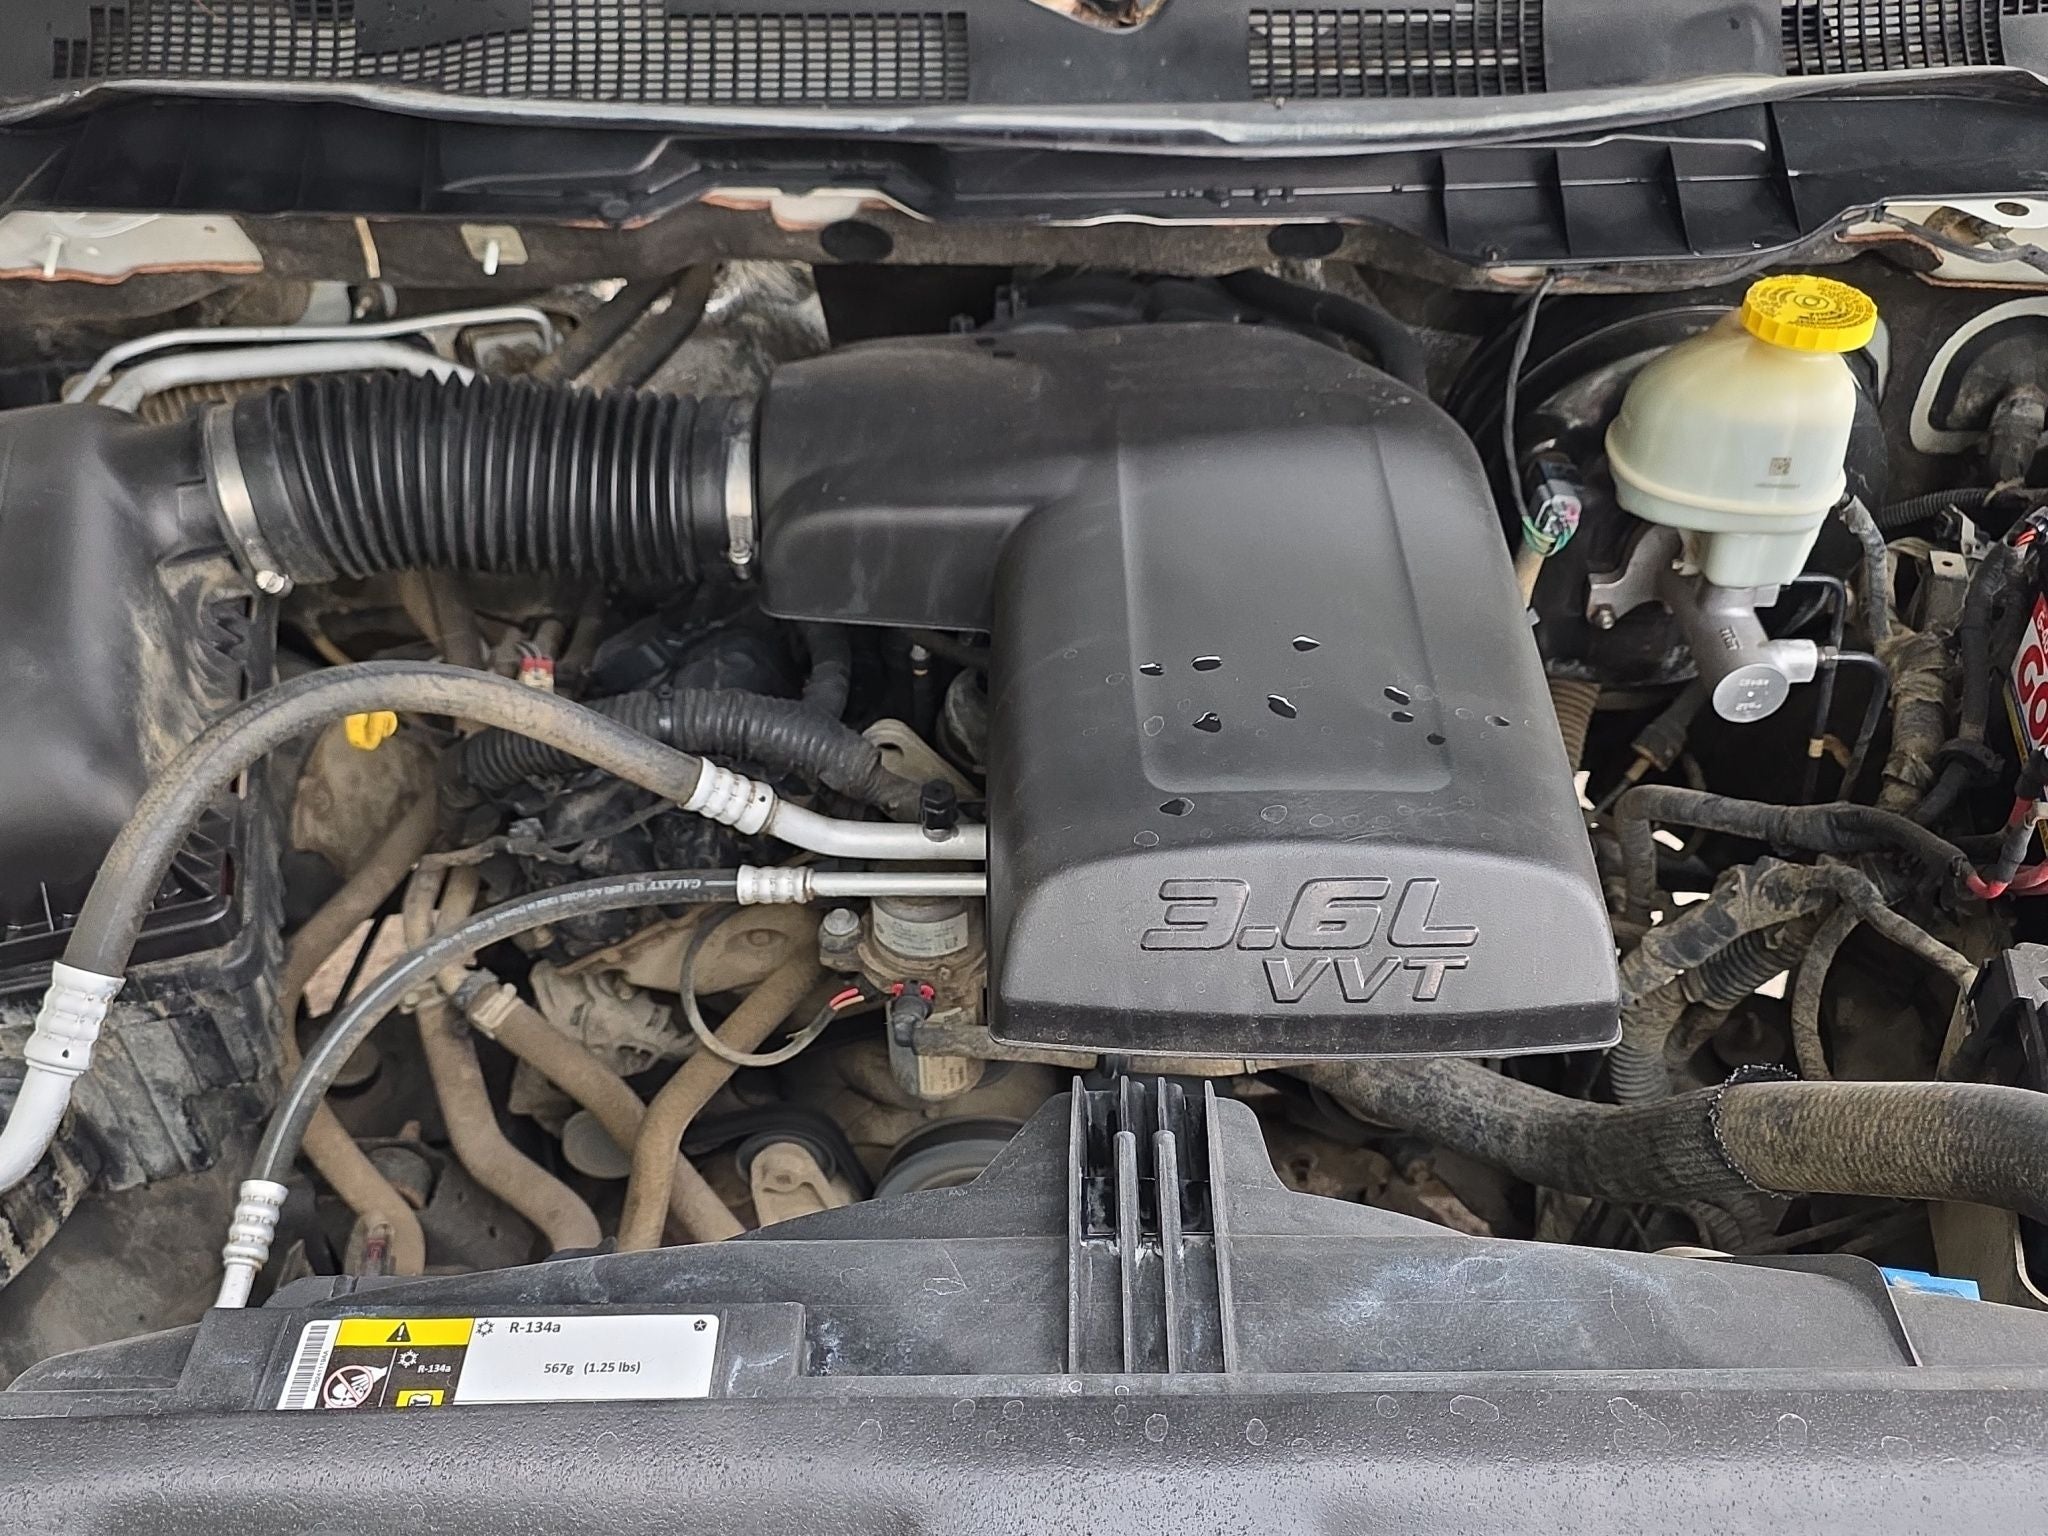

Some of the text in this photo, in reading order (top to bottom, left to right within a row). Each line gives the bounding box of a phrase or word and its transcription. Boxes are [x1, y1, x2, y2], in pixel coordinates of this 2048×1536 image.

[2018, 644, 2048, 745] GO
[646, 878, 701, 892] GALAXY
[1140, 875, 1479, 951] 3.6L
[1262, 954, 1469, 1004] VVT
[509, 1321, 561, 1333] R-134a
[417, 1364, 451, 1373] R-134a
[543, 1361, 641, 1376] 567g (1.25 lbs)
